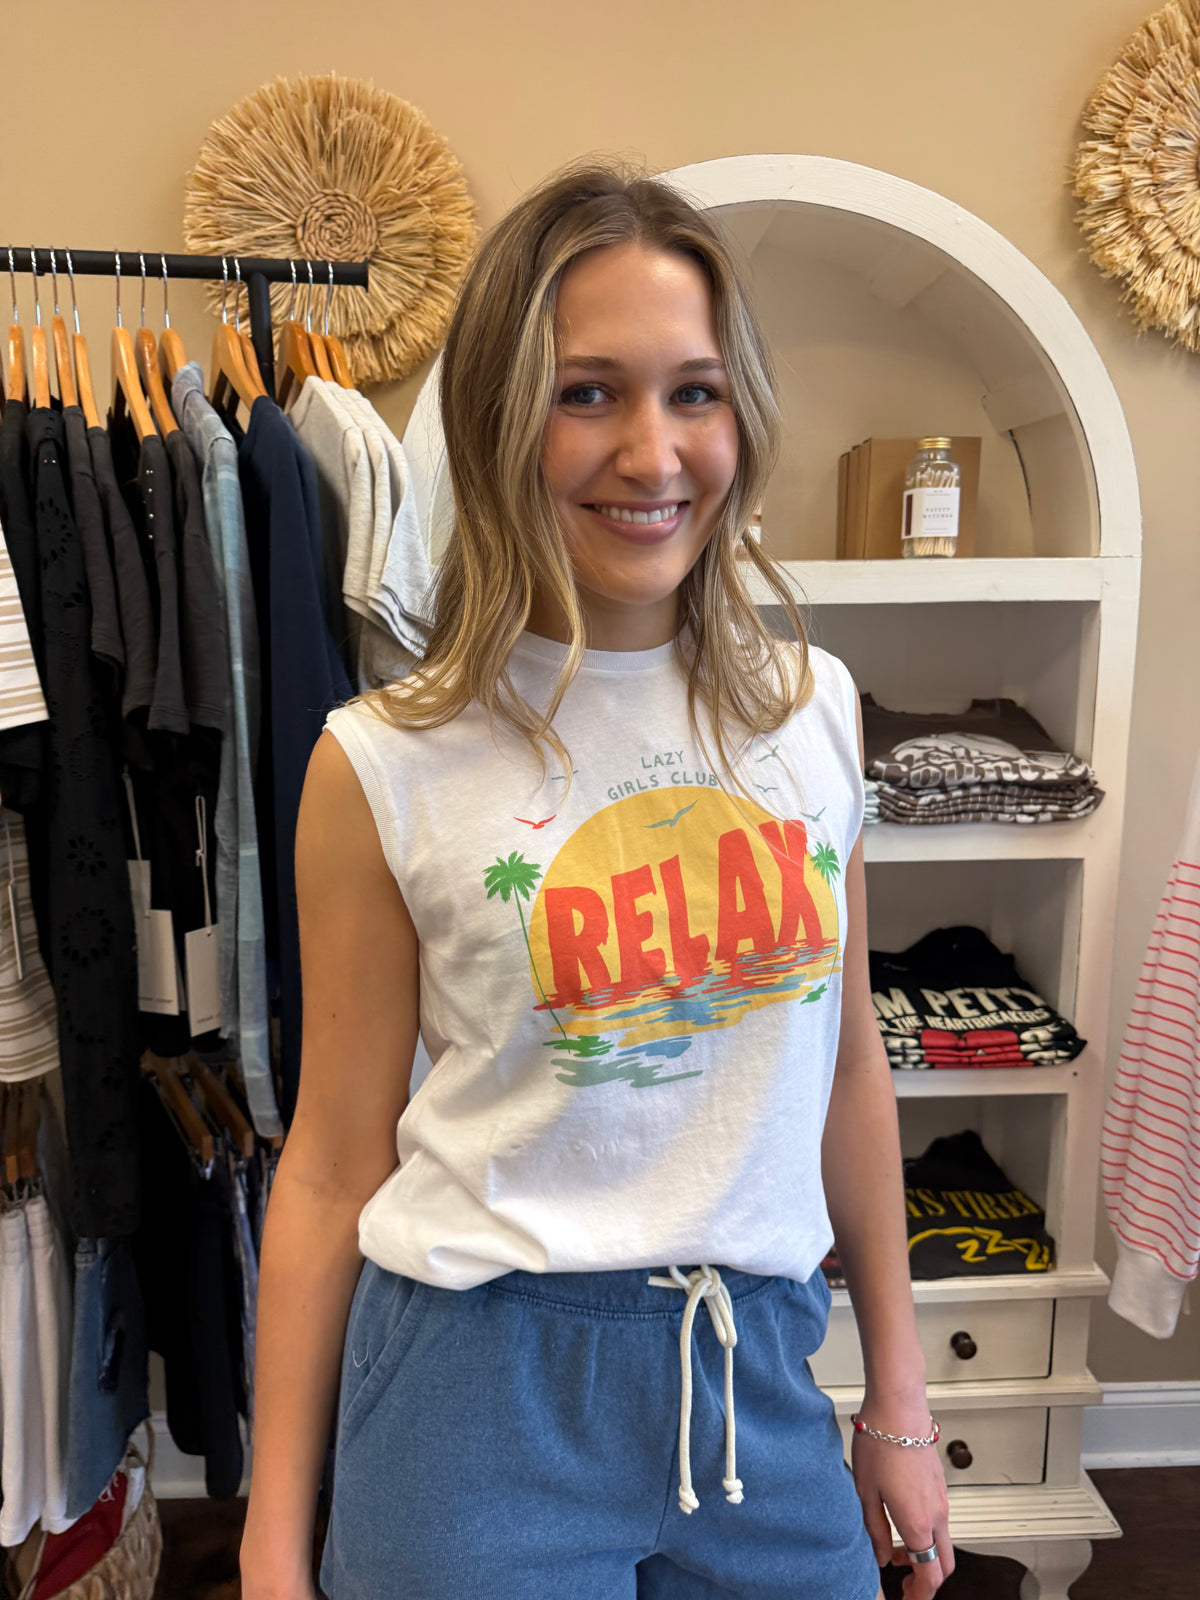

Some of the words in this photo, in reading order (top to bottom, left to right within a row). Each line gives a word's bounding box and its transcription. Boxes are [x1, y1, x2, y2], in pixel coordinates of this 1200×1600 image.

[641, 750, 684, 769] LAZY
[607, 774, 659, 800] GIRLS
[670, 771, 719, 787] CLUB
[544, 819, 824, 1000] RELAX
[890, 1015, 924, 1032] THE
[924, 1008, 1051, 1031] HEARTBREAKERS
